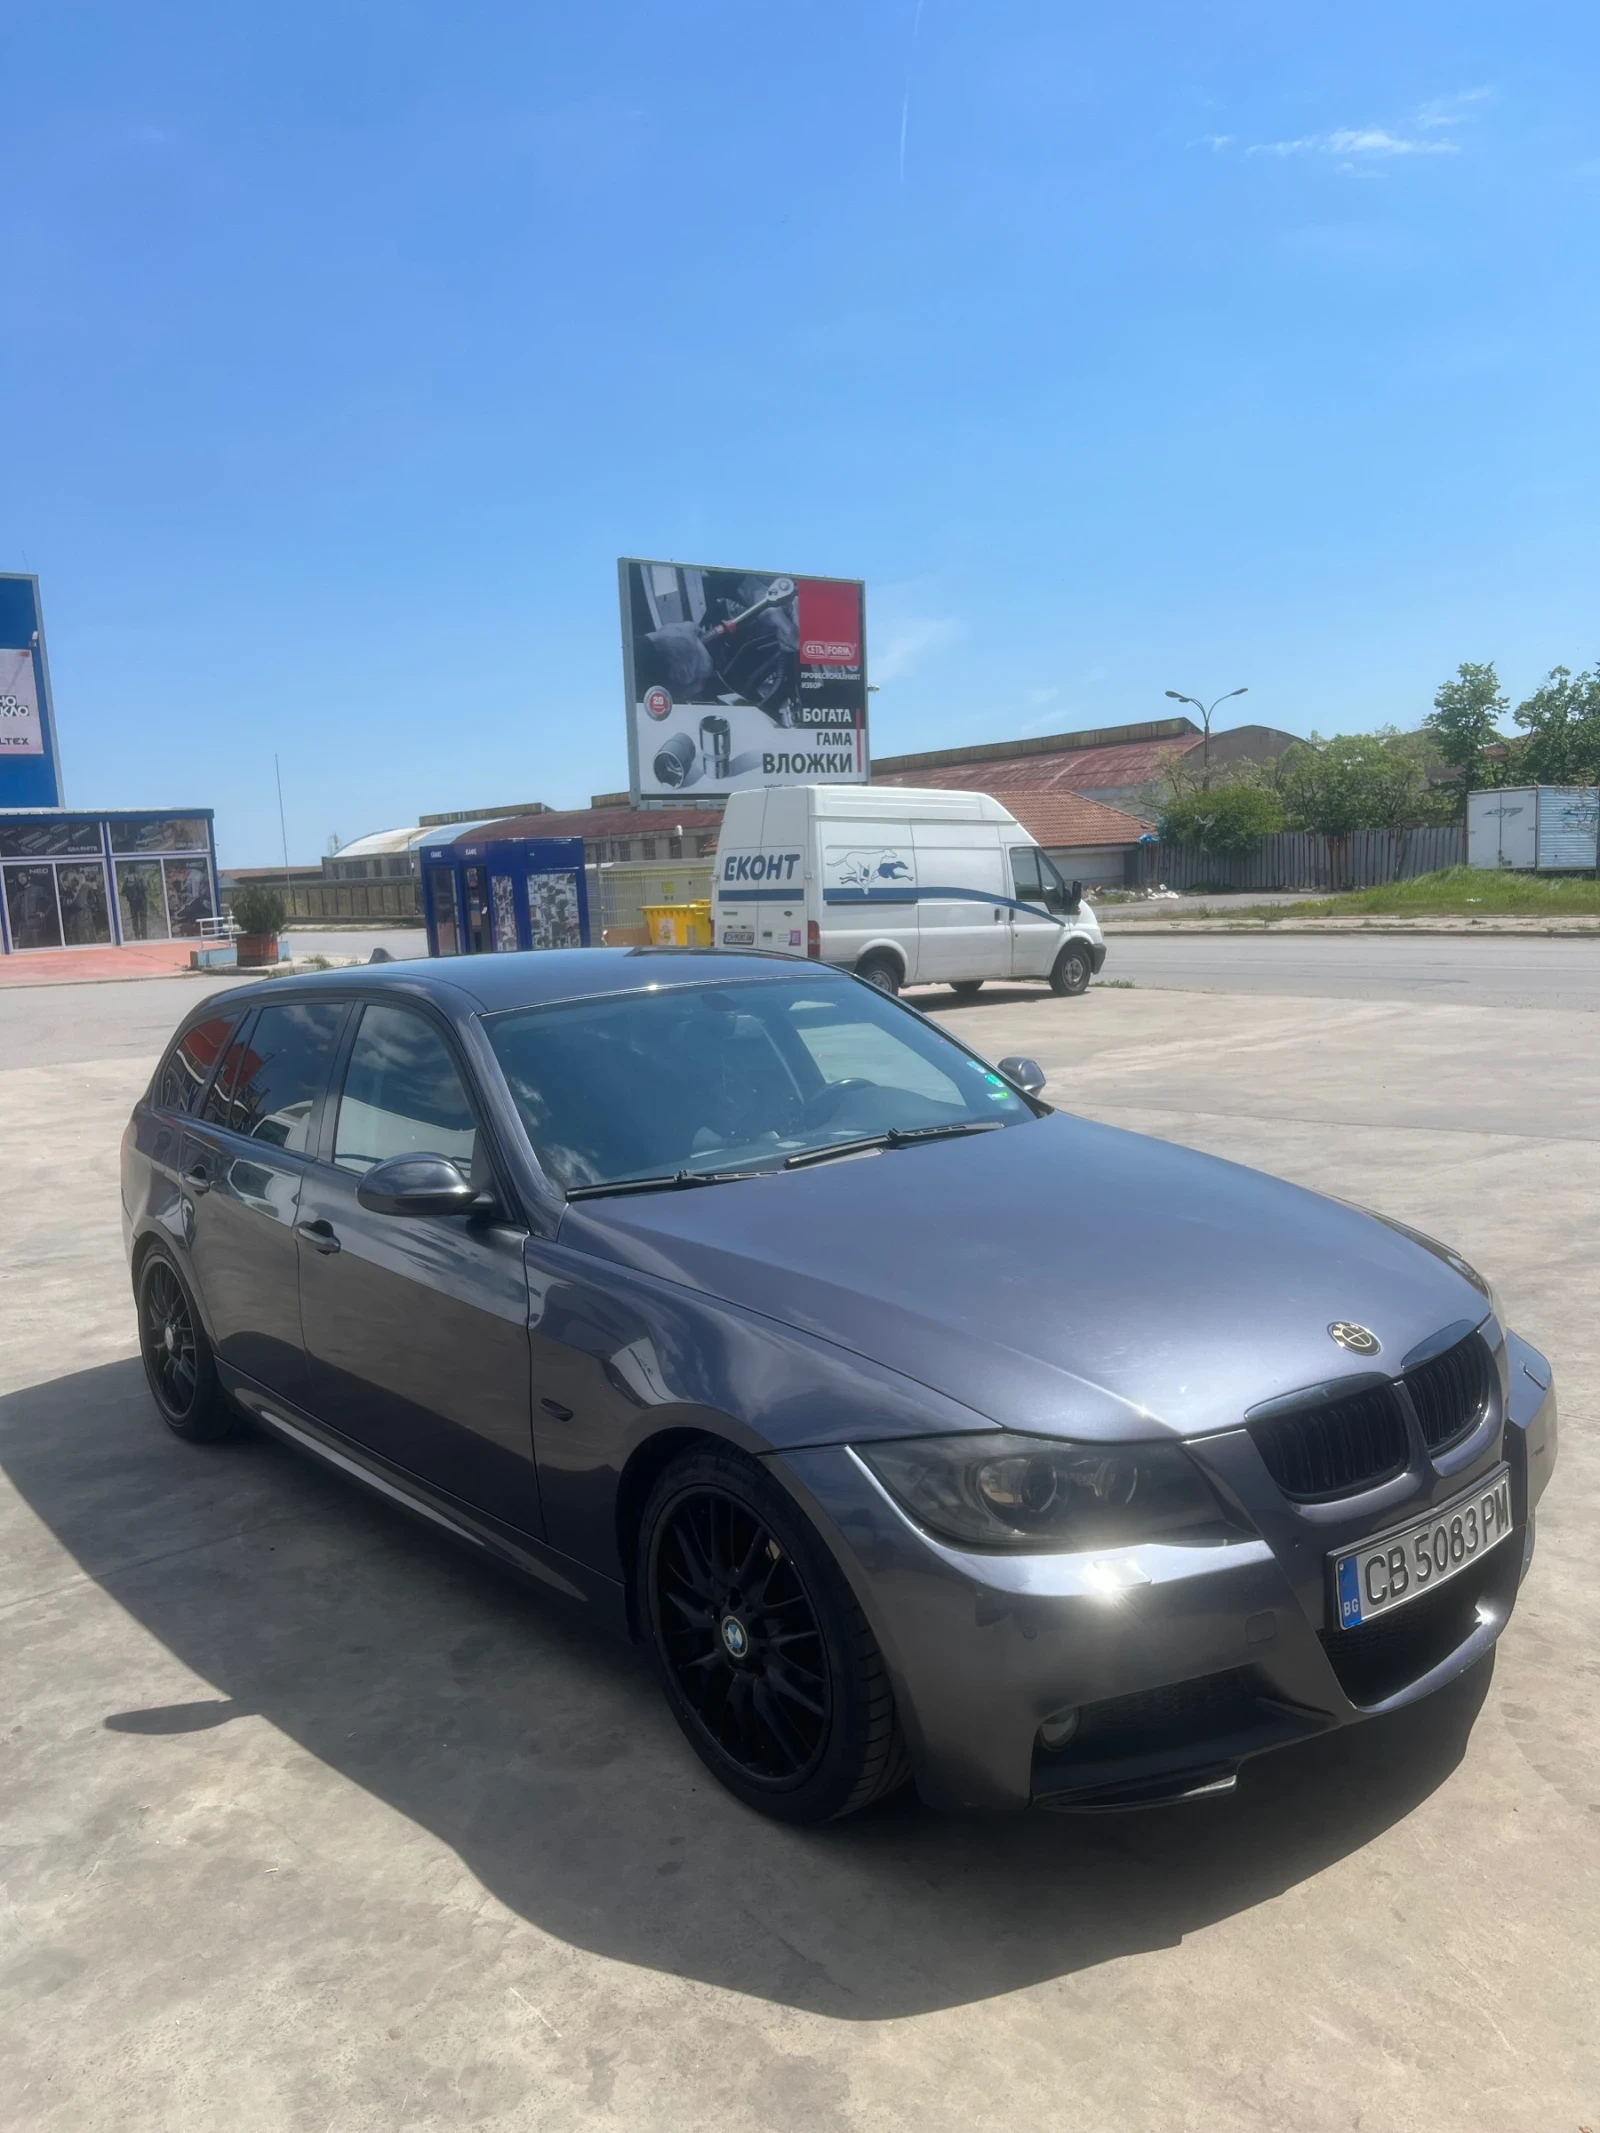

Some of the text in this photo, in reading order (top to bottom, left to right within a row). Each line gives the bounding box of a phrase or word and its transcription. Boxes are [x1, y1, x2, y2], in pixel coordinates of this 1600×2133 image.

[806, 644, 851, 656] CETA FORM
[802, 708, 852, 722] БОГАТА
[816, 732, 852, 745] ГАМА
[762, 753, 853, 774] ВЛОЖКИ
[724, 853, 801, 881] ЕКОНТ
[1365, 1480, 1510, 1605] CB 5083 PM
[1343, 1598, 1359, 1616] BG
